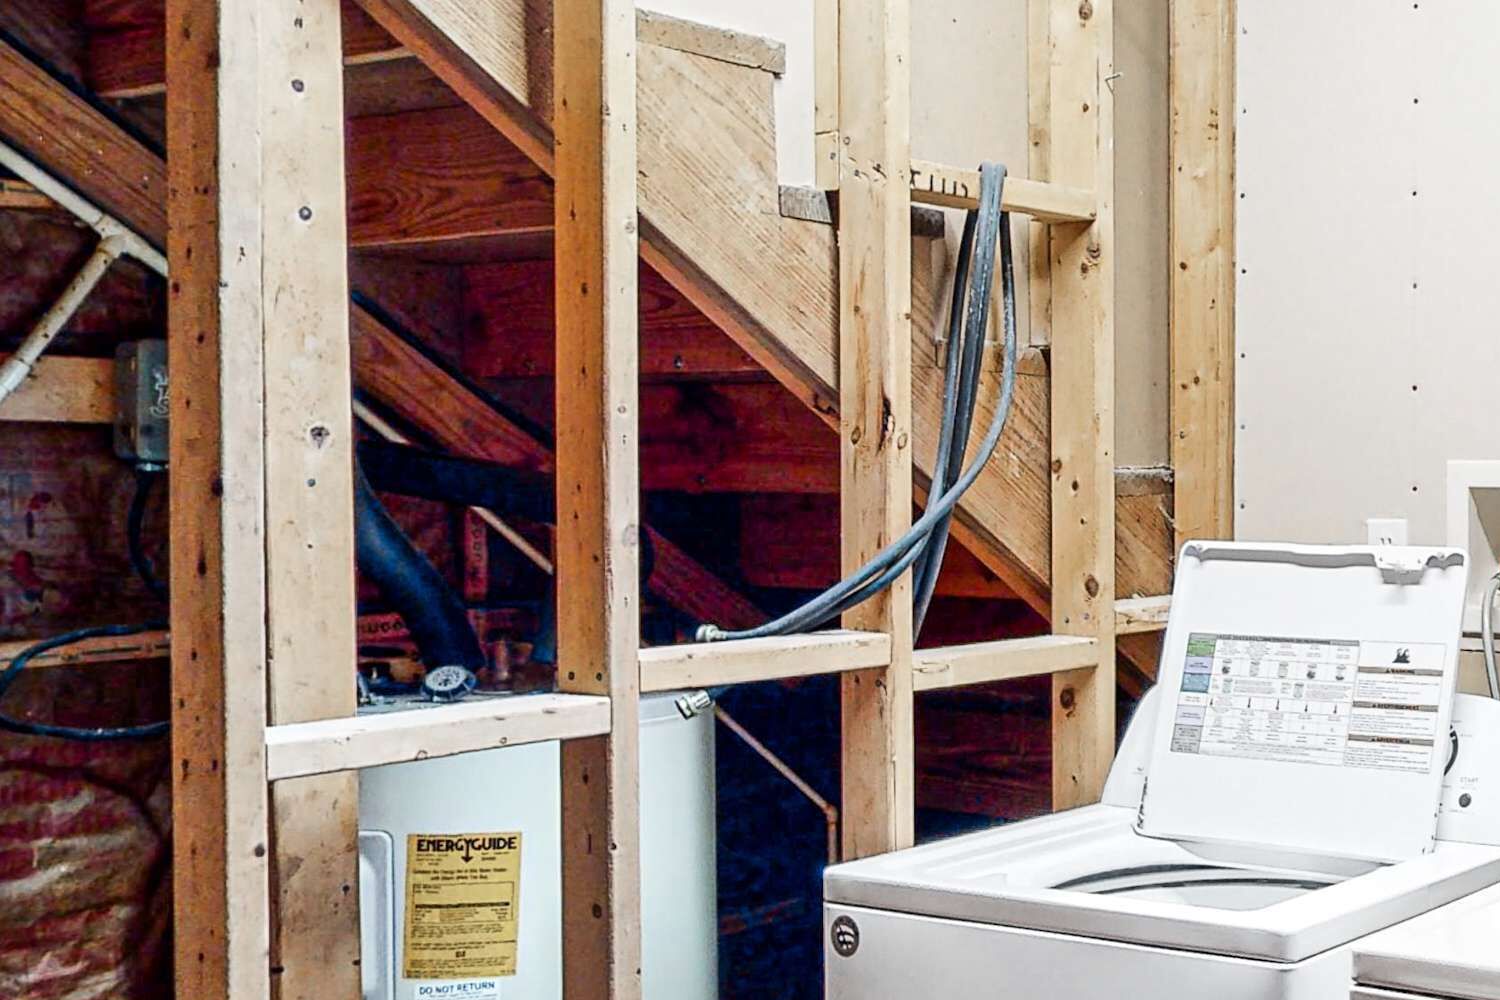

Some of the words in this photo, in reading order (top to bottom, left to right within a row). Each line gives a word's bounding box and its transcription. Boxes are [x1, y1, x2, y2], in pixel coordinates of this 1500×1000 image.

[416, 836, 517, 852] ENERGYGUIDE
[419, 986, 433, 996] DO
[435, 984, 454, 994] NOT
[456, 982, 496, 992] RETURN
